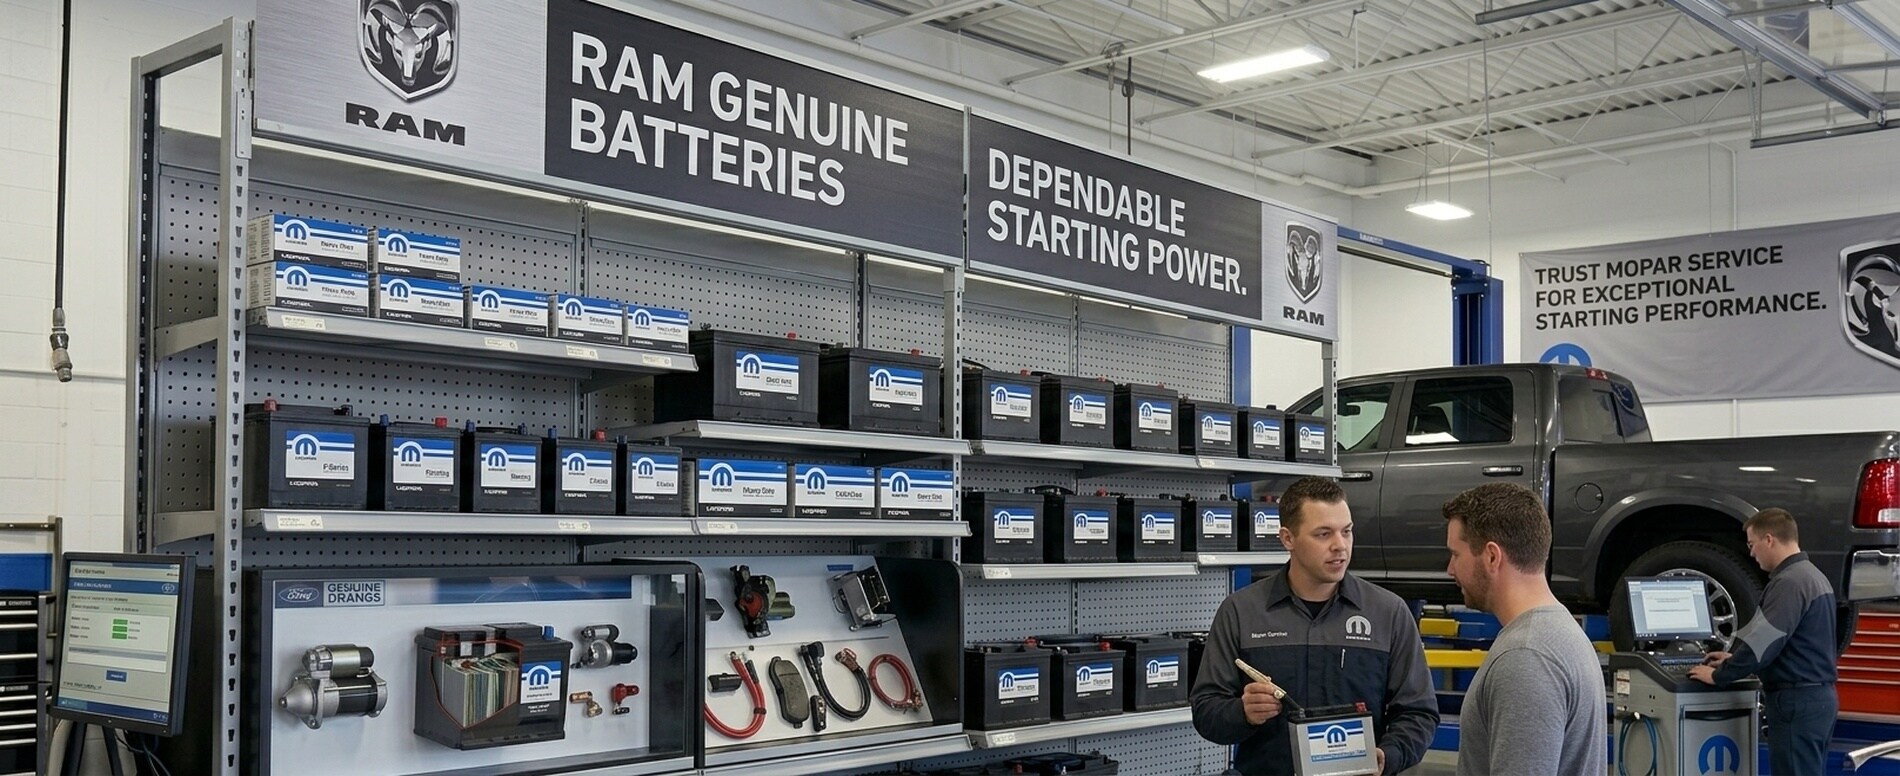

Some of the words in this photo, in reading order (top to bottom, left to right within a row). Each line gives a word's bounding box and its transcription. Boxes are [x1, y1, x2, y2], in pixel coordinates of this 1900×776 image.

[572, 31, 693, 112] RAM
[709, 71, 909, 166] GENUINE
[345, 102, 466, 147] RAM
[570, 97, 845, 207] BATTERIES
[988, 147, 1186, 237] DEPENDABLE
[987, 199, 1140, 271] STARTING
[1147, 237, 1247, 296] POWER.
[1535, 263, 1600, 286] TRUST
[1606, 255, 1682, 280] MOPAR
[1687, 245, 1784, 271] SERVICE
[1535, 288, 1577, 308] FOR
[1582, 274, 1735, 304] EXCEPTIONAL
[1535, 305, 1639, 331] STARTING
[1645, 290, 1827, 323] PERFORMANCE.
[1282, 305, 1325, 326] RAM
[328, 592, 381, 603] DRANGS
